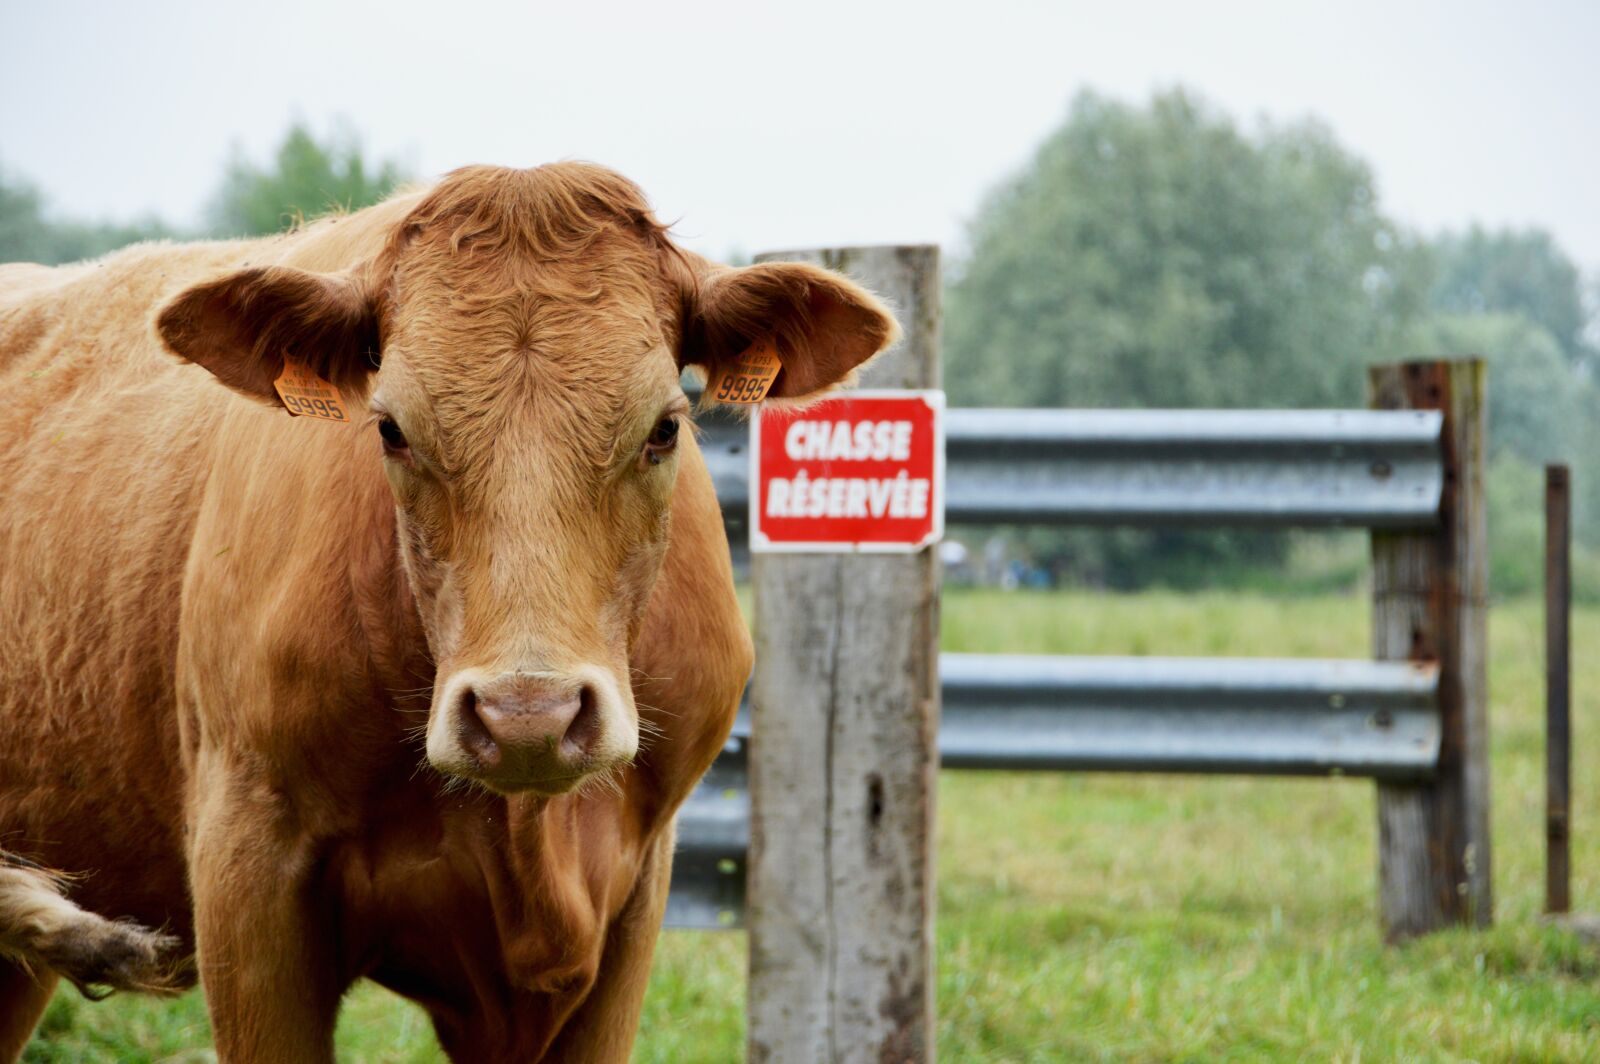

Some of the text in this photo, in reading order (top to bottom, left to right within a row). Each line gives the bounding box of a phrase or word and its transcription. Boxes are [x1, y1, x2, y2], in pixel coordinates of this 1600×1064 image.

[717, 375, 769, 401] 9995
[285, 395, 344, 419] 9995
[785, 420, 913, 461] CHASSE
[766, 468, 930, 518] RÉSERVÉE
